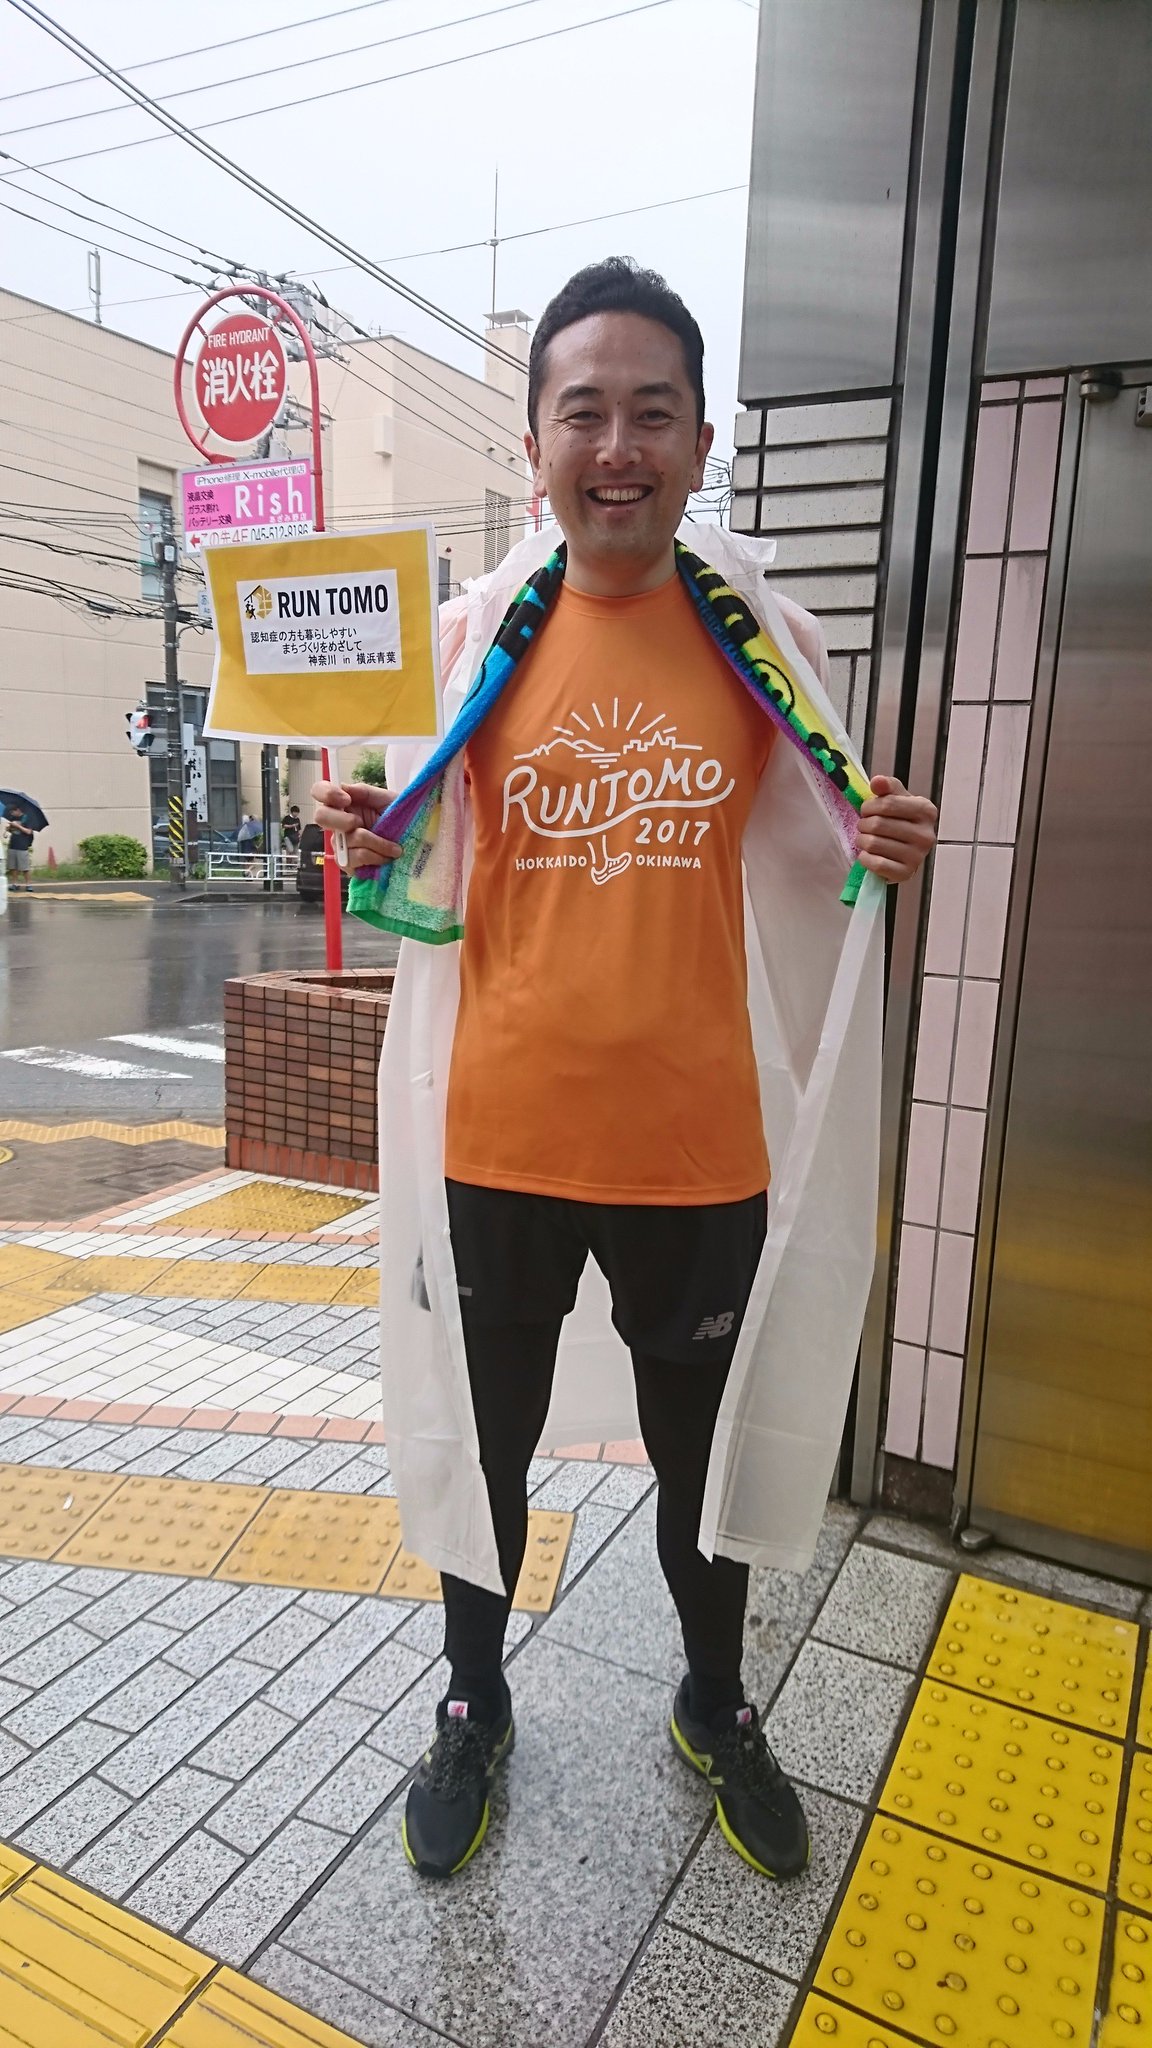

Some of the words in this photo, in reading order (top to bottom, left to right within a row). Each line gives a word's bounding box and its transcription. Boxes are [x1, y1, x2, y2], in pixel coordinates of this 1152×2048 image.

[208, 333, 227, 349] FIRE
[229, 327, 270, 346] HYDRANT
[201, 349, 280, 407] 消火栓
[234, 475, 303, 519] Rish
[188, 514, 232, 528] バッテリー交換
[277, 589, 321, 619] RUN
[325, 584, 389, 616] TOMO
[250, 627, 358, 643] 認知症の方も暮らしやすい
[282, 640, 363, 655] まちづくりをめざして
[308, 654, 337, 667] 神奈川
[343, 655, 351, 664] in
[356, 651, 396, 665] 横浜青葉
[635, 817, 711, 846] 2017
[515, 855, 588, 871] HOKKAIDO
[635, 854, 702, 869] OKINAWA
